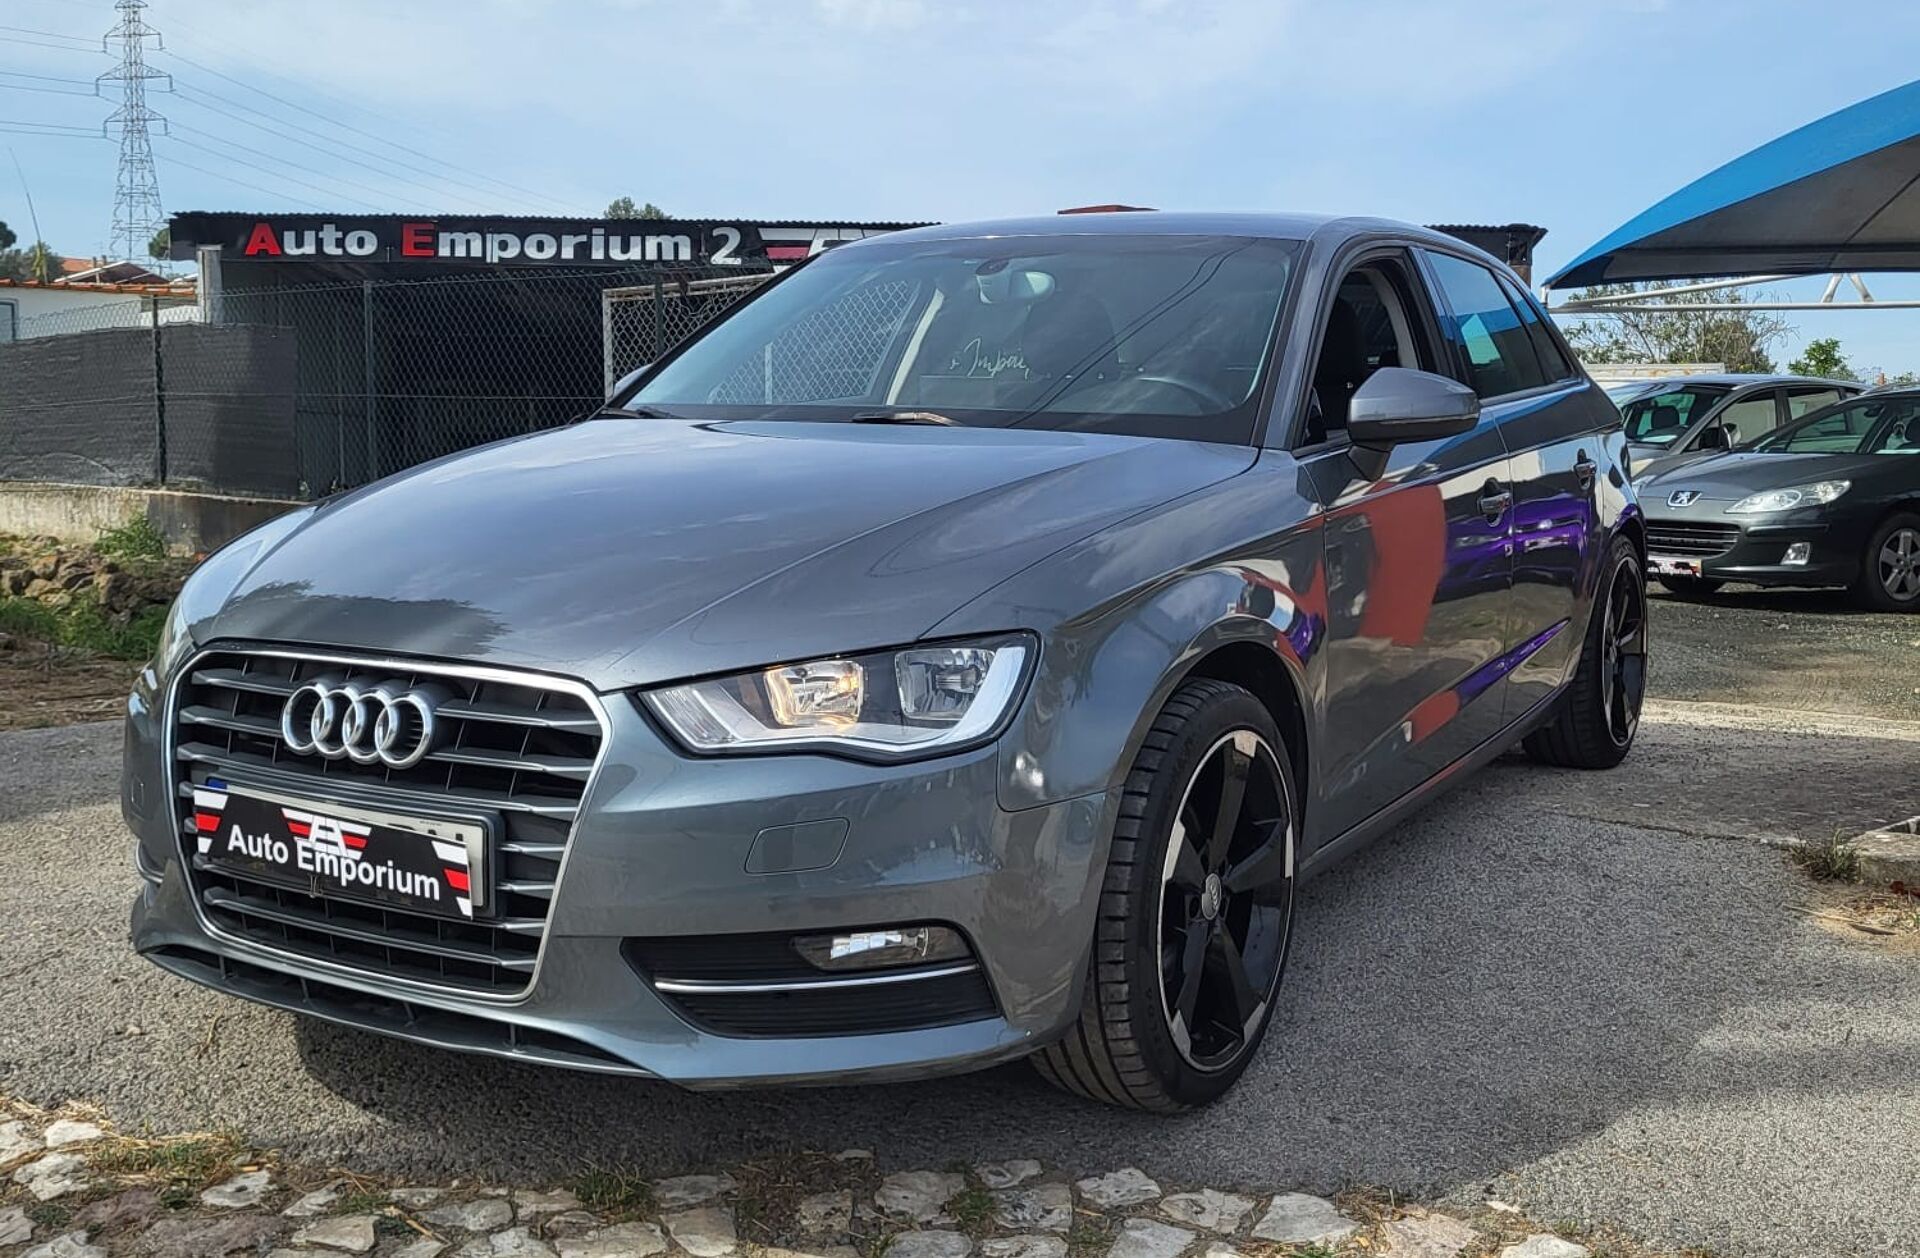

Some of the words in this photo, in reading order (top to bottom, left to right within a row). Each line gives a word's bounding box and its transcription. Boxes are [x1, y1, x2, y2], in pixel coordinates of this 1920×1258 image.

[244, 222, 378, 256] Auto
[402, 222, 691, 263] Emporium
[709, 226, 742, 265] 2
[228, 824, 289, 864] Auto
[297, 840, 440, 901] Emporium
